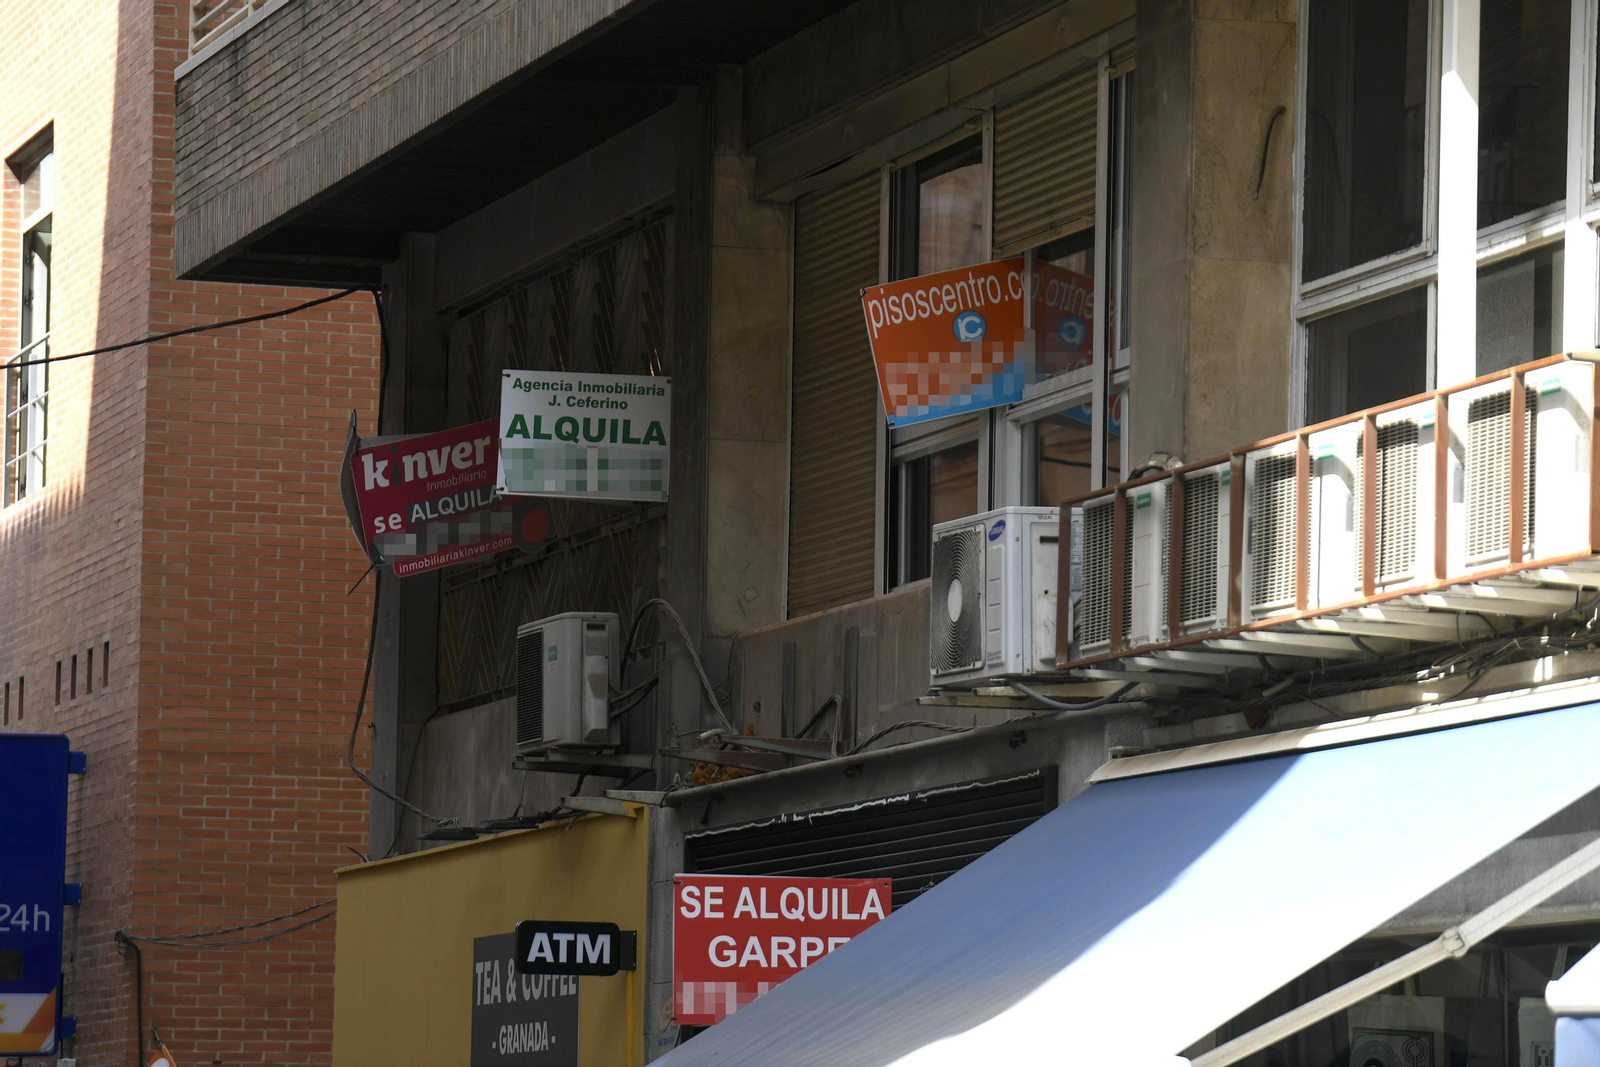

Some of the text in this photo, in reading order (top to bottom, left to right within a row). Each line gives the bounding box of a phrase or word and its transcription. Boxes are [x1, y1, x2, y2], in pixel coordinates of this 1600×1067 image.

[868, 270, 1025, 338] pisoscentro.c
[512, 377, 665, 396] Agencia Inmobiliaria
[548, 395, 628, 410] J. Ceferino
[505, 413, 667, 446] ALQUILA
[361, 435, 491, 491] kinver
[427, 469, 487, 492] inmobiliaria
[373, 484, 502, 533] se ALQUILA
[399, 537, 513, 573] inmobiliariakinver.com
[0, 903, 50, 932] 24h
[680, 885, 885, 922] SE ALQUILA
[526, 932, 611, 964] ATM
[475, 959, 502, 1006] TEA
[506, 958, 517, 1003] &
